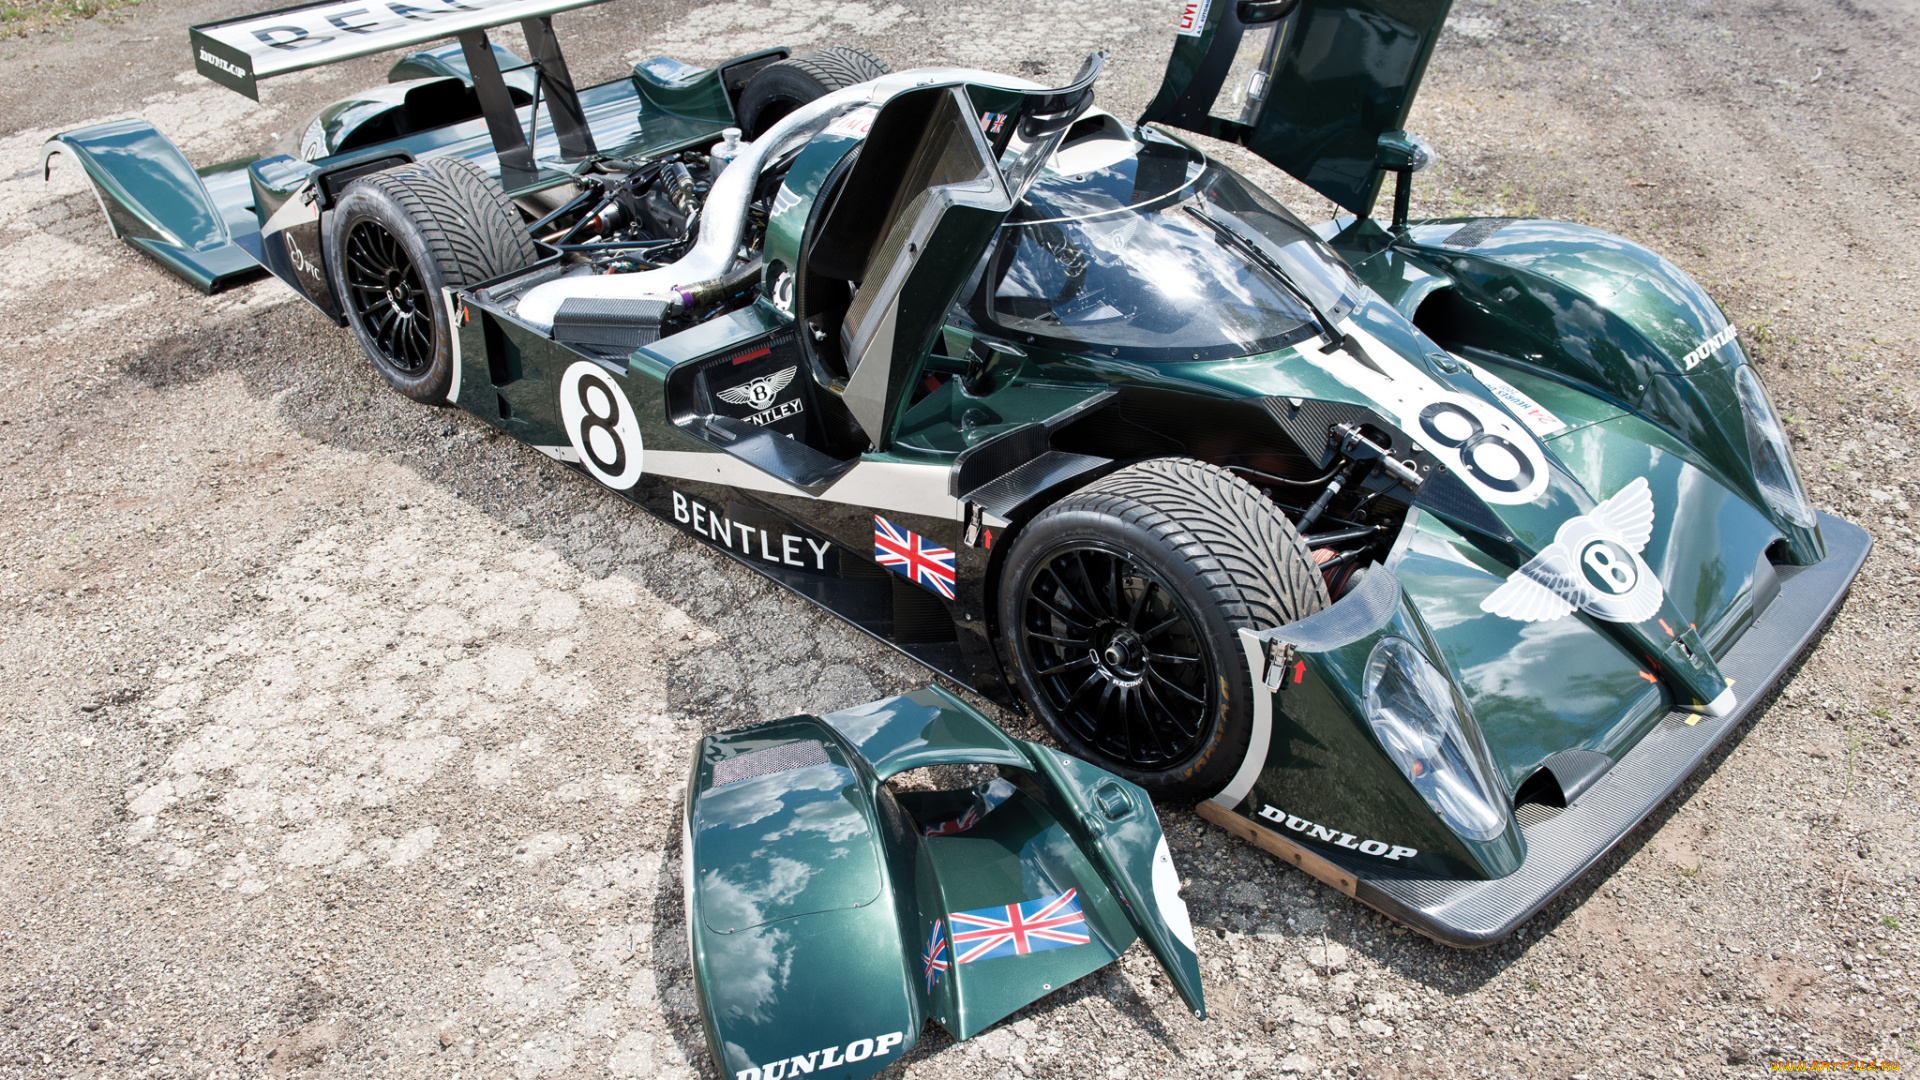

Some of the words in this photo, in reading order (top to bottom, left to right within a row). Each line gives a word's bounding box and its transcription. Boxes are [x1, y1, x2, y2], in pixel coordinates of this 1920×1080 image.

[199, 49, 246, 79] DUNLOP
[304, 260, 321, 281] PTC
[742, 400, 800, 426] NTLEY
[1496, 390, 1532, 410] HEURES
[1528, 409, 1558, 425] 24
[577, 374, 627, 477] 8
[1418, 401, 1536, 493] 8
[672, 490, 832, 570] BENTLEY
[1584, 543, 1637, 594] B
[1257, 803, 1418, 861] DUNLOP
